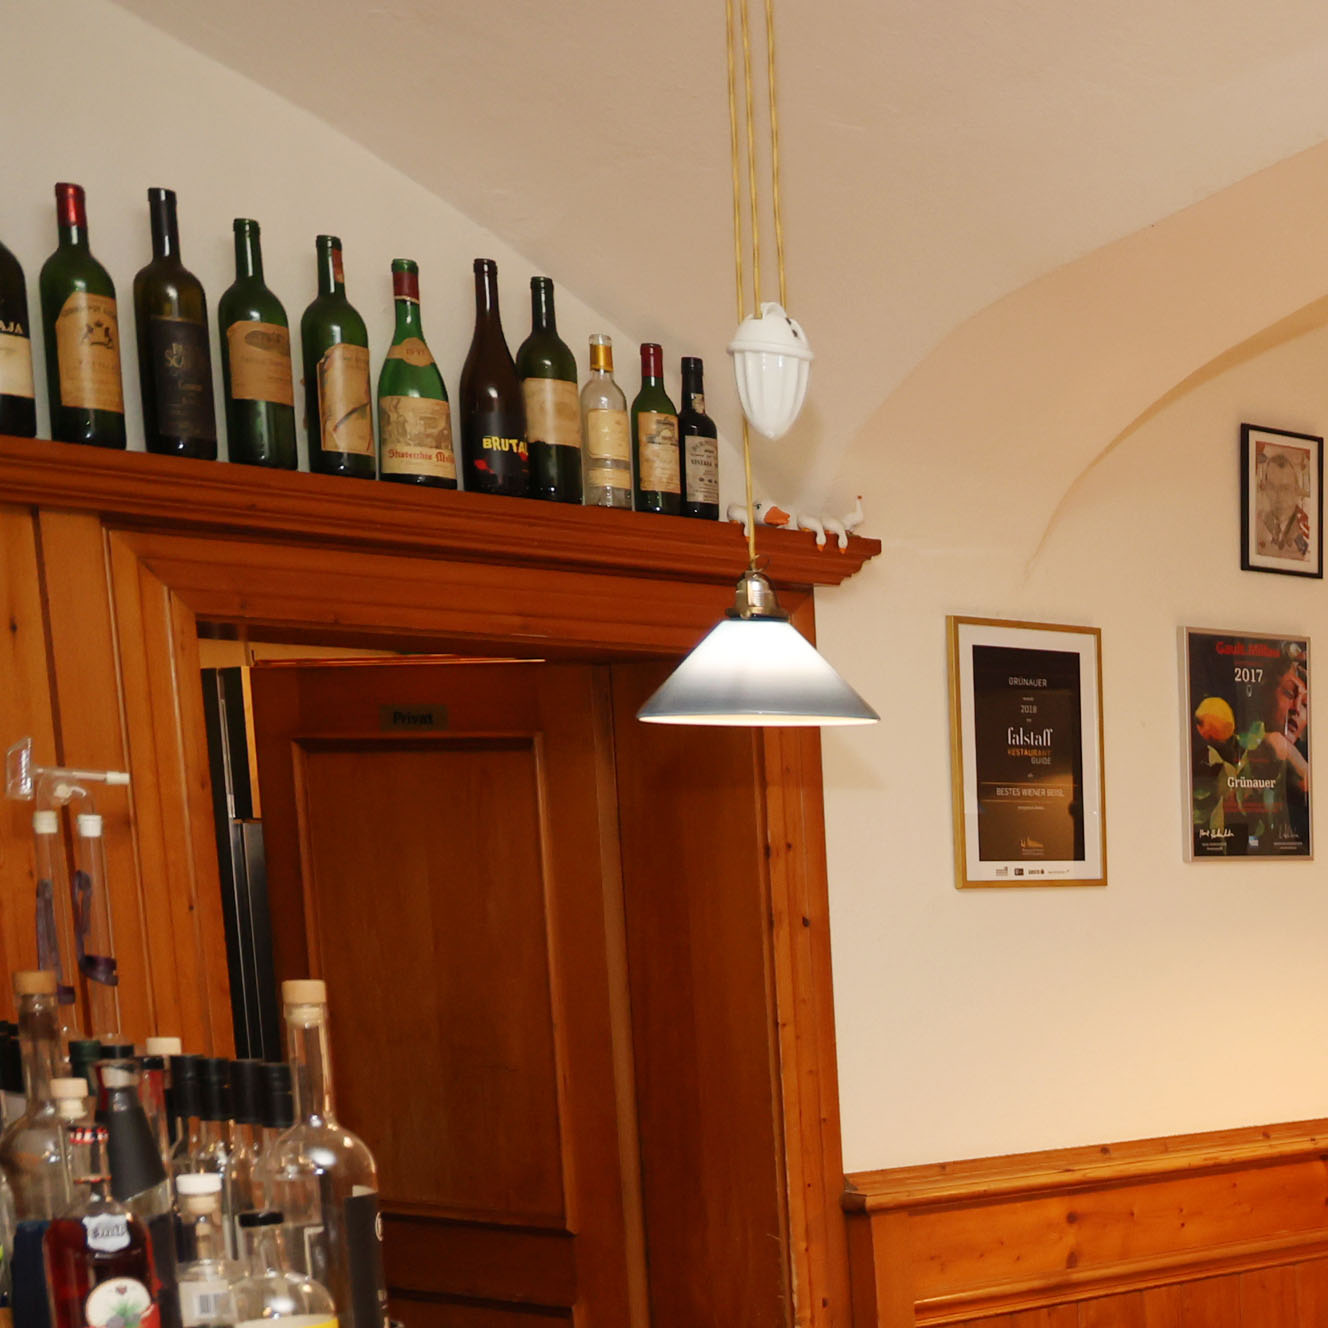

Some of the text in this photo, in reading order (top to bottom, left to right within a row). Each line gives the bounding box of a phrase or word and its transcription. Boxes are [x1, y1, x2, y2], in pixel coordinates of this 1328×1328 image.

[1234, 667, 1264, 683] 2017
[392, 711, 434, 726] Privat
[1007, 727, 1054, 747] falstaff
[1227, 776, 1277, 789] Grünauer
[996, 787, 1021, 797] BESTES
